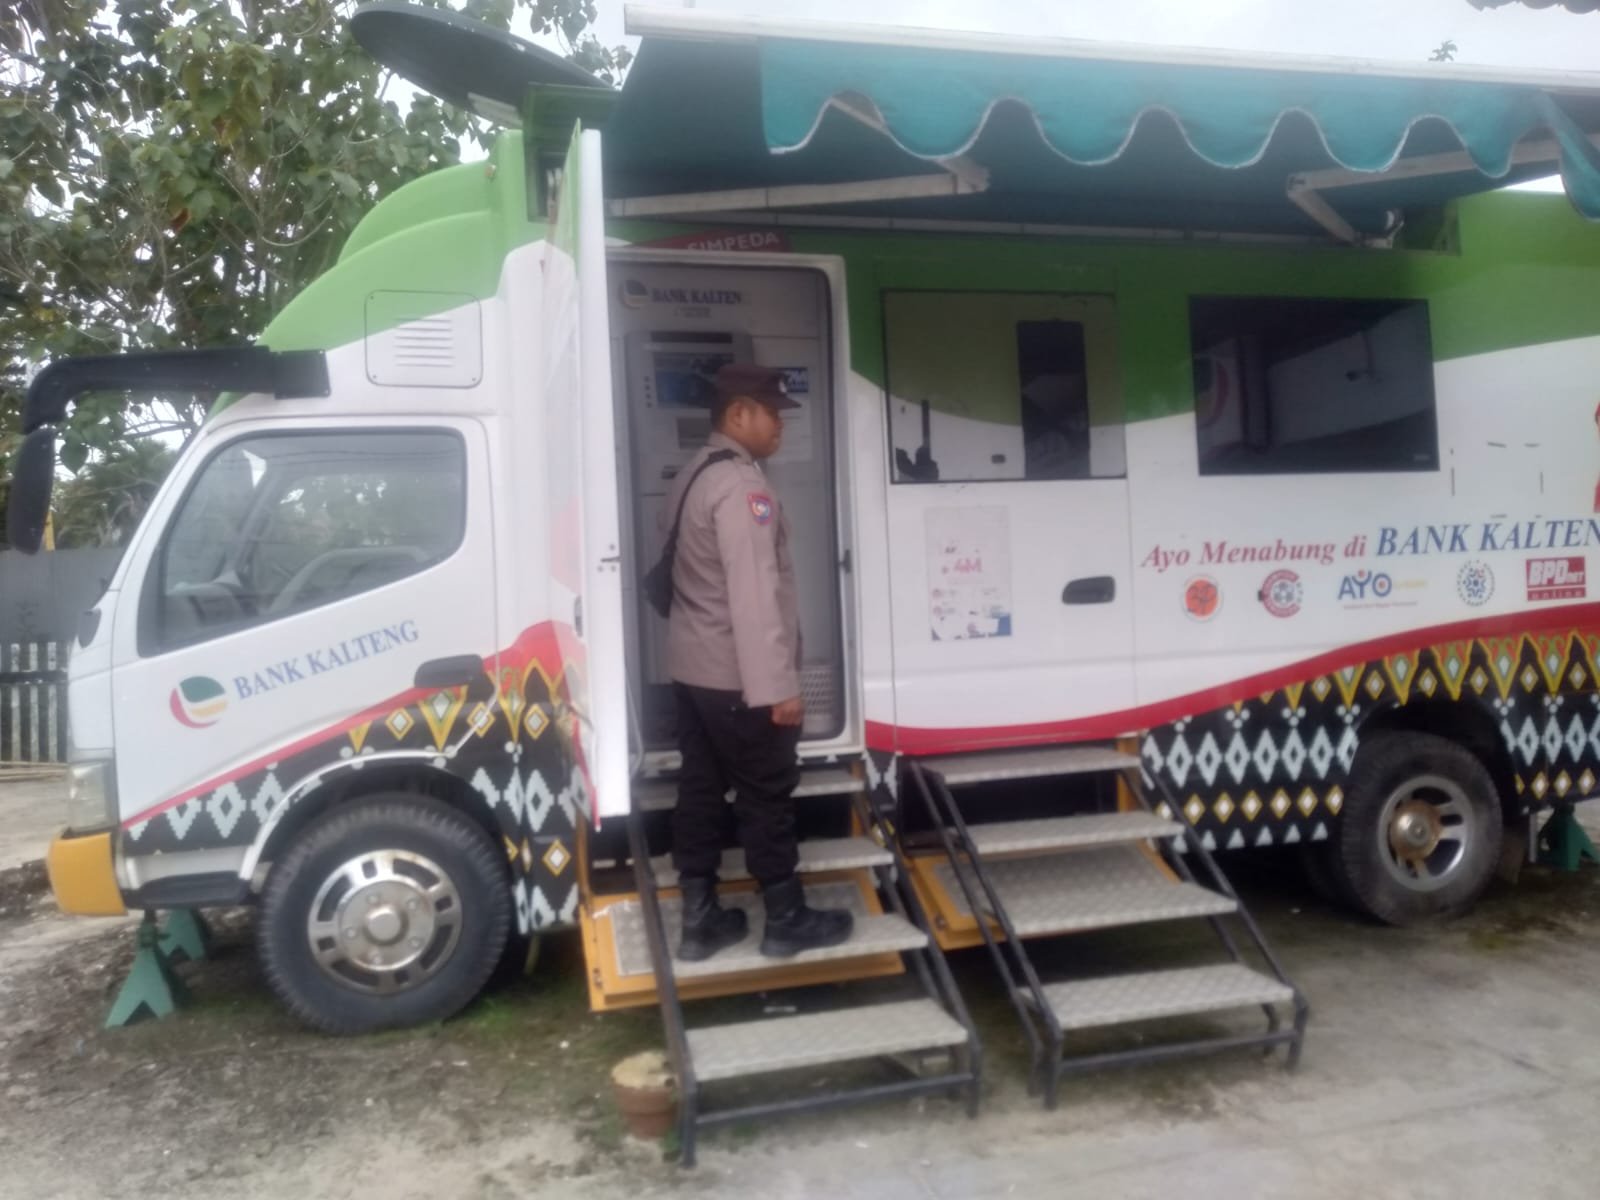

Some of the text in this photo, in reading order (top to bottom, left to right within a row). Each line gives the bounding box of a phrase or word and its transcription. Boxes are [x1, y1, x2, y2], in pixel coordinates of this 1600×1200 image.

[652, 287, 688, 302] BANK
[1140, 518, 1600, 573] Ayo Menabung di BANK KALTEN
[1338, 569, 1393, 600] AYO
[233, 619, 419, 699] BANK KALTENG
